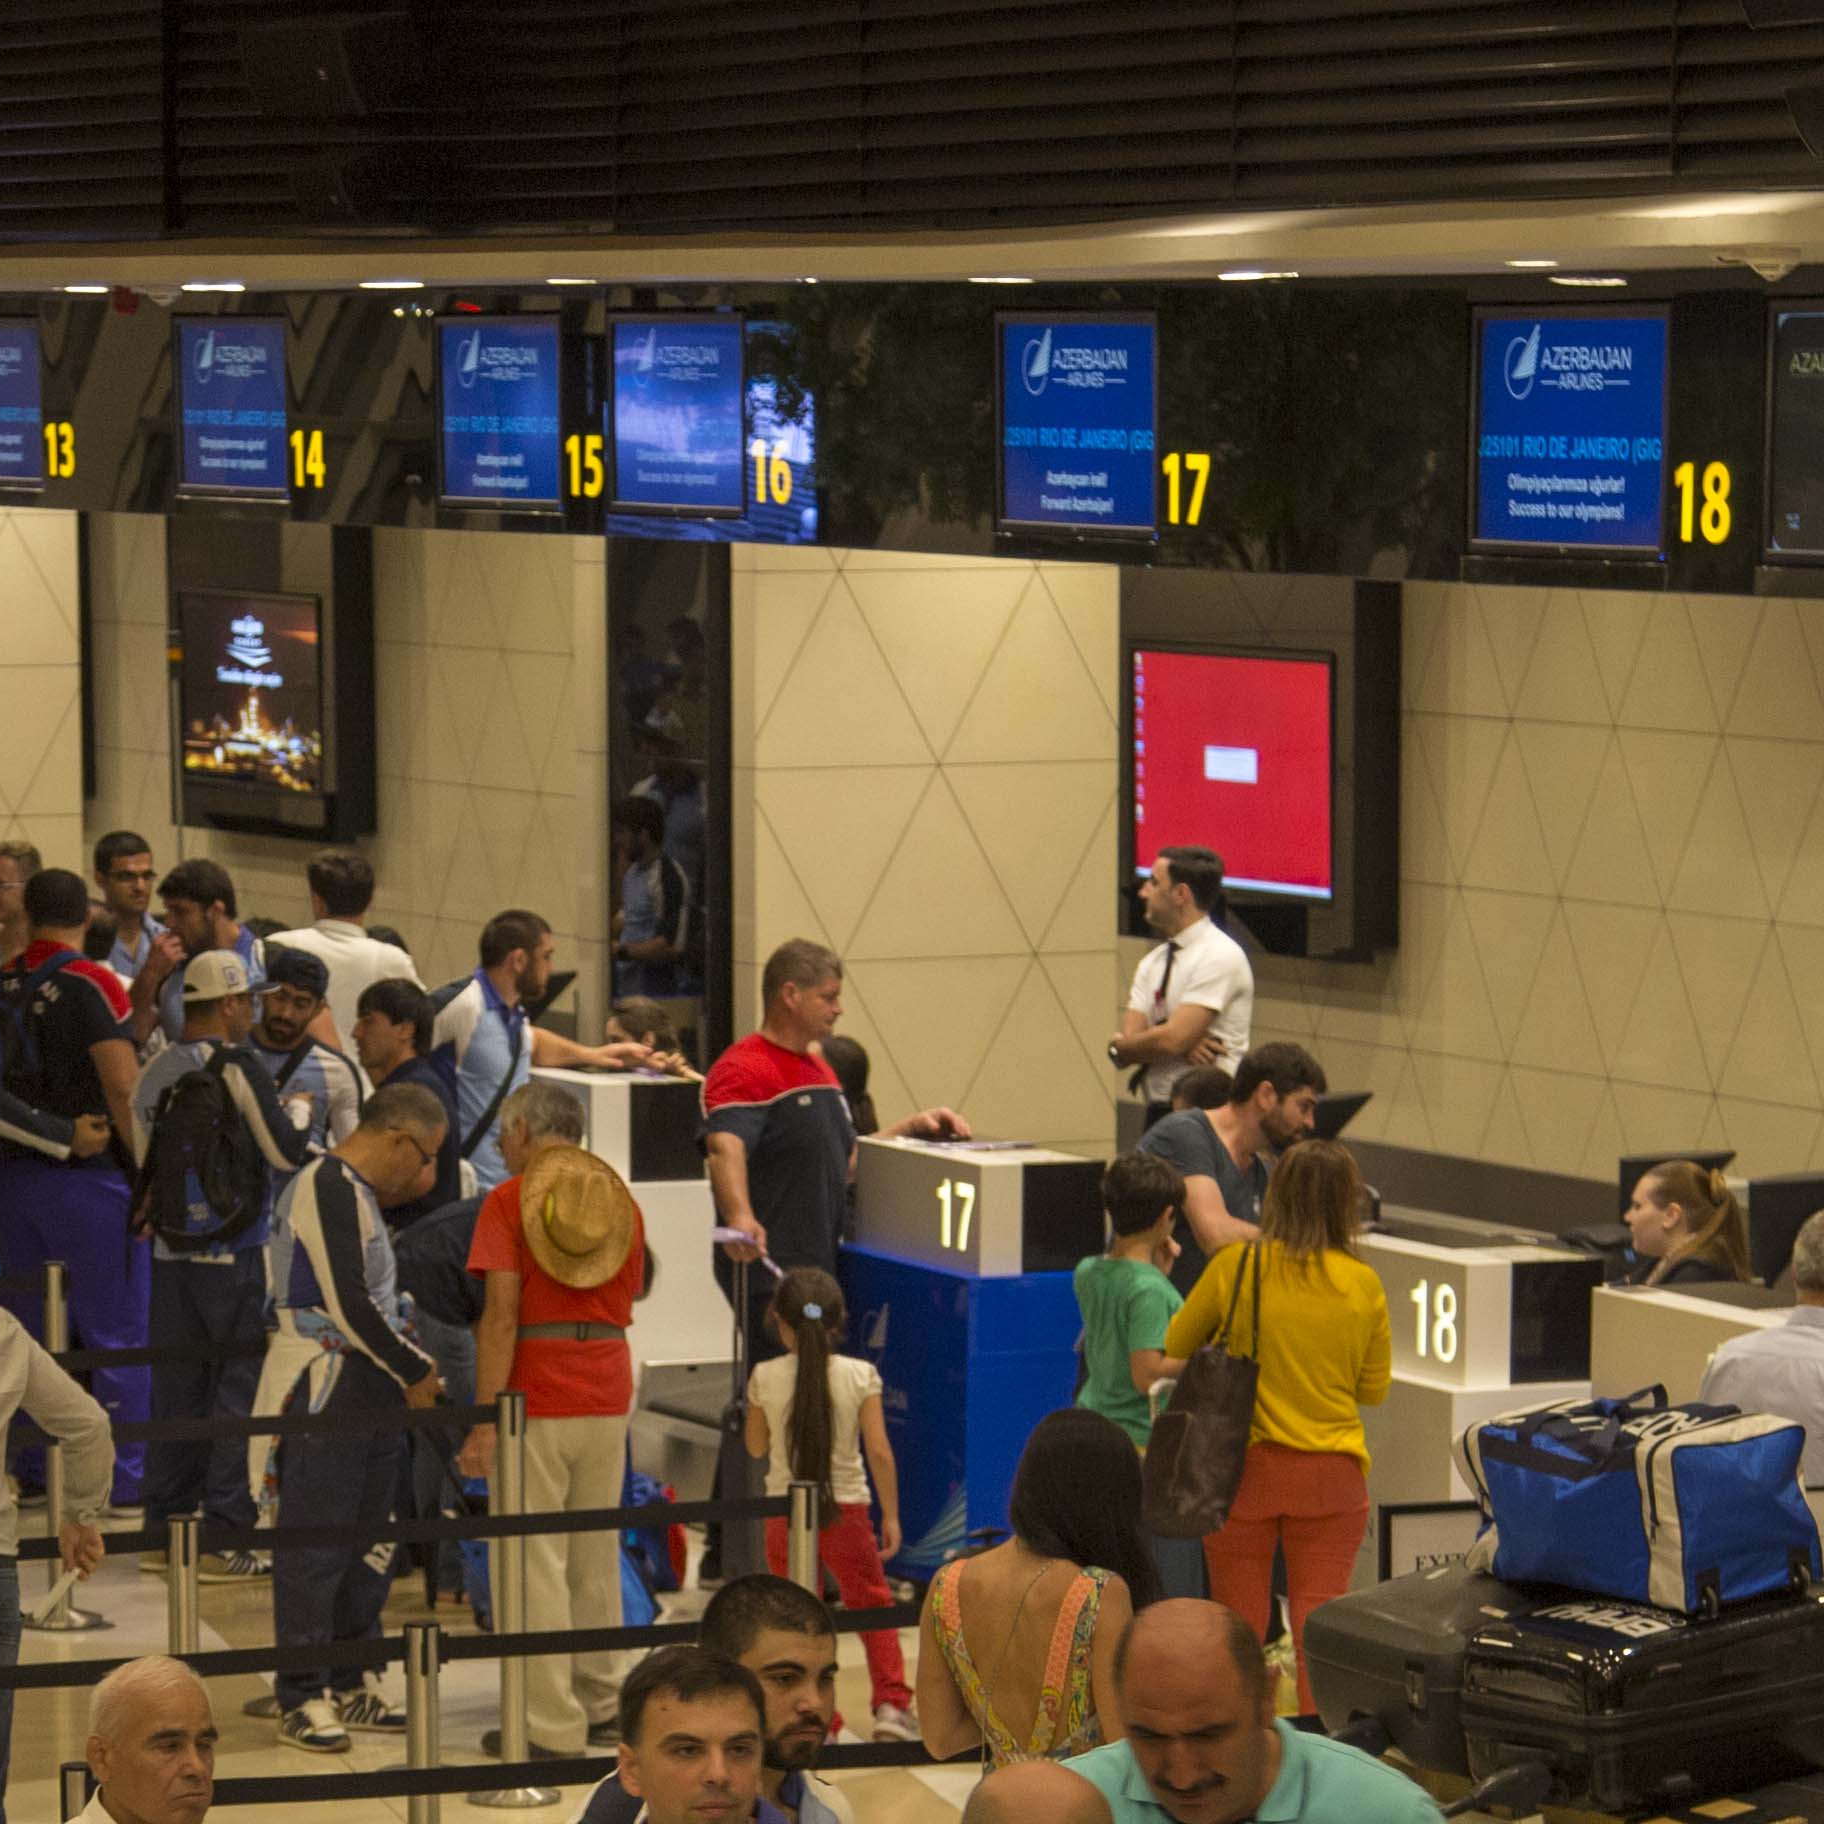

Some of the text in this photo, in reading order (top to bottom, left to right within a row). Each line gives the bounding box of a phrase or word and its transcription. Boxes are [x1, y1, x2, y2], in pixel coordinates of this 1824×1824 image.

[1540, 346, 1632, 371] AZERBAIJAN
[43, 421, 76, 478] 13
[289, 429, 327, 489] 14
[564, 433, 604, 498] 15
[749, 438, 793, 505] 16
[1523, 435, 1546, 458] RIO
[1549, 436, 1568, 459] DE
[1571, 437, 1628, 461] JANEIRO
[1161, 451, 1212, 526] 17
[1673, 460, 1732, 545] 18
[935, 1177, 977, 1253] 17
[1410, 1278, 1458, 1364] 18
